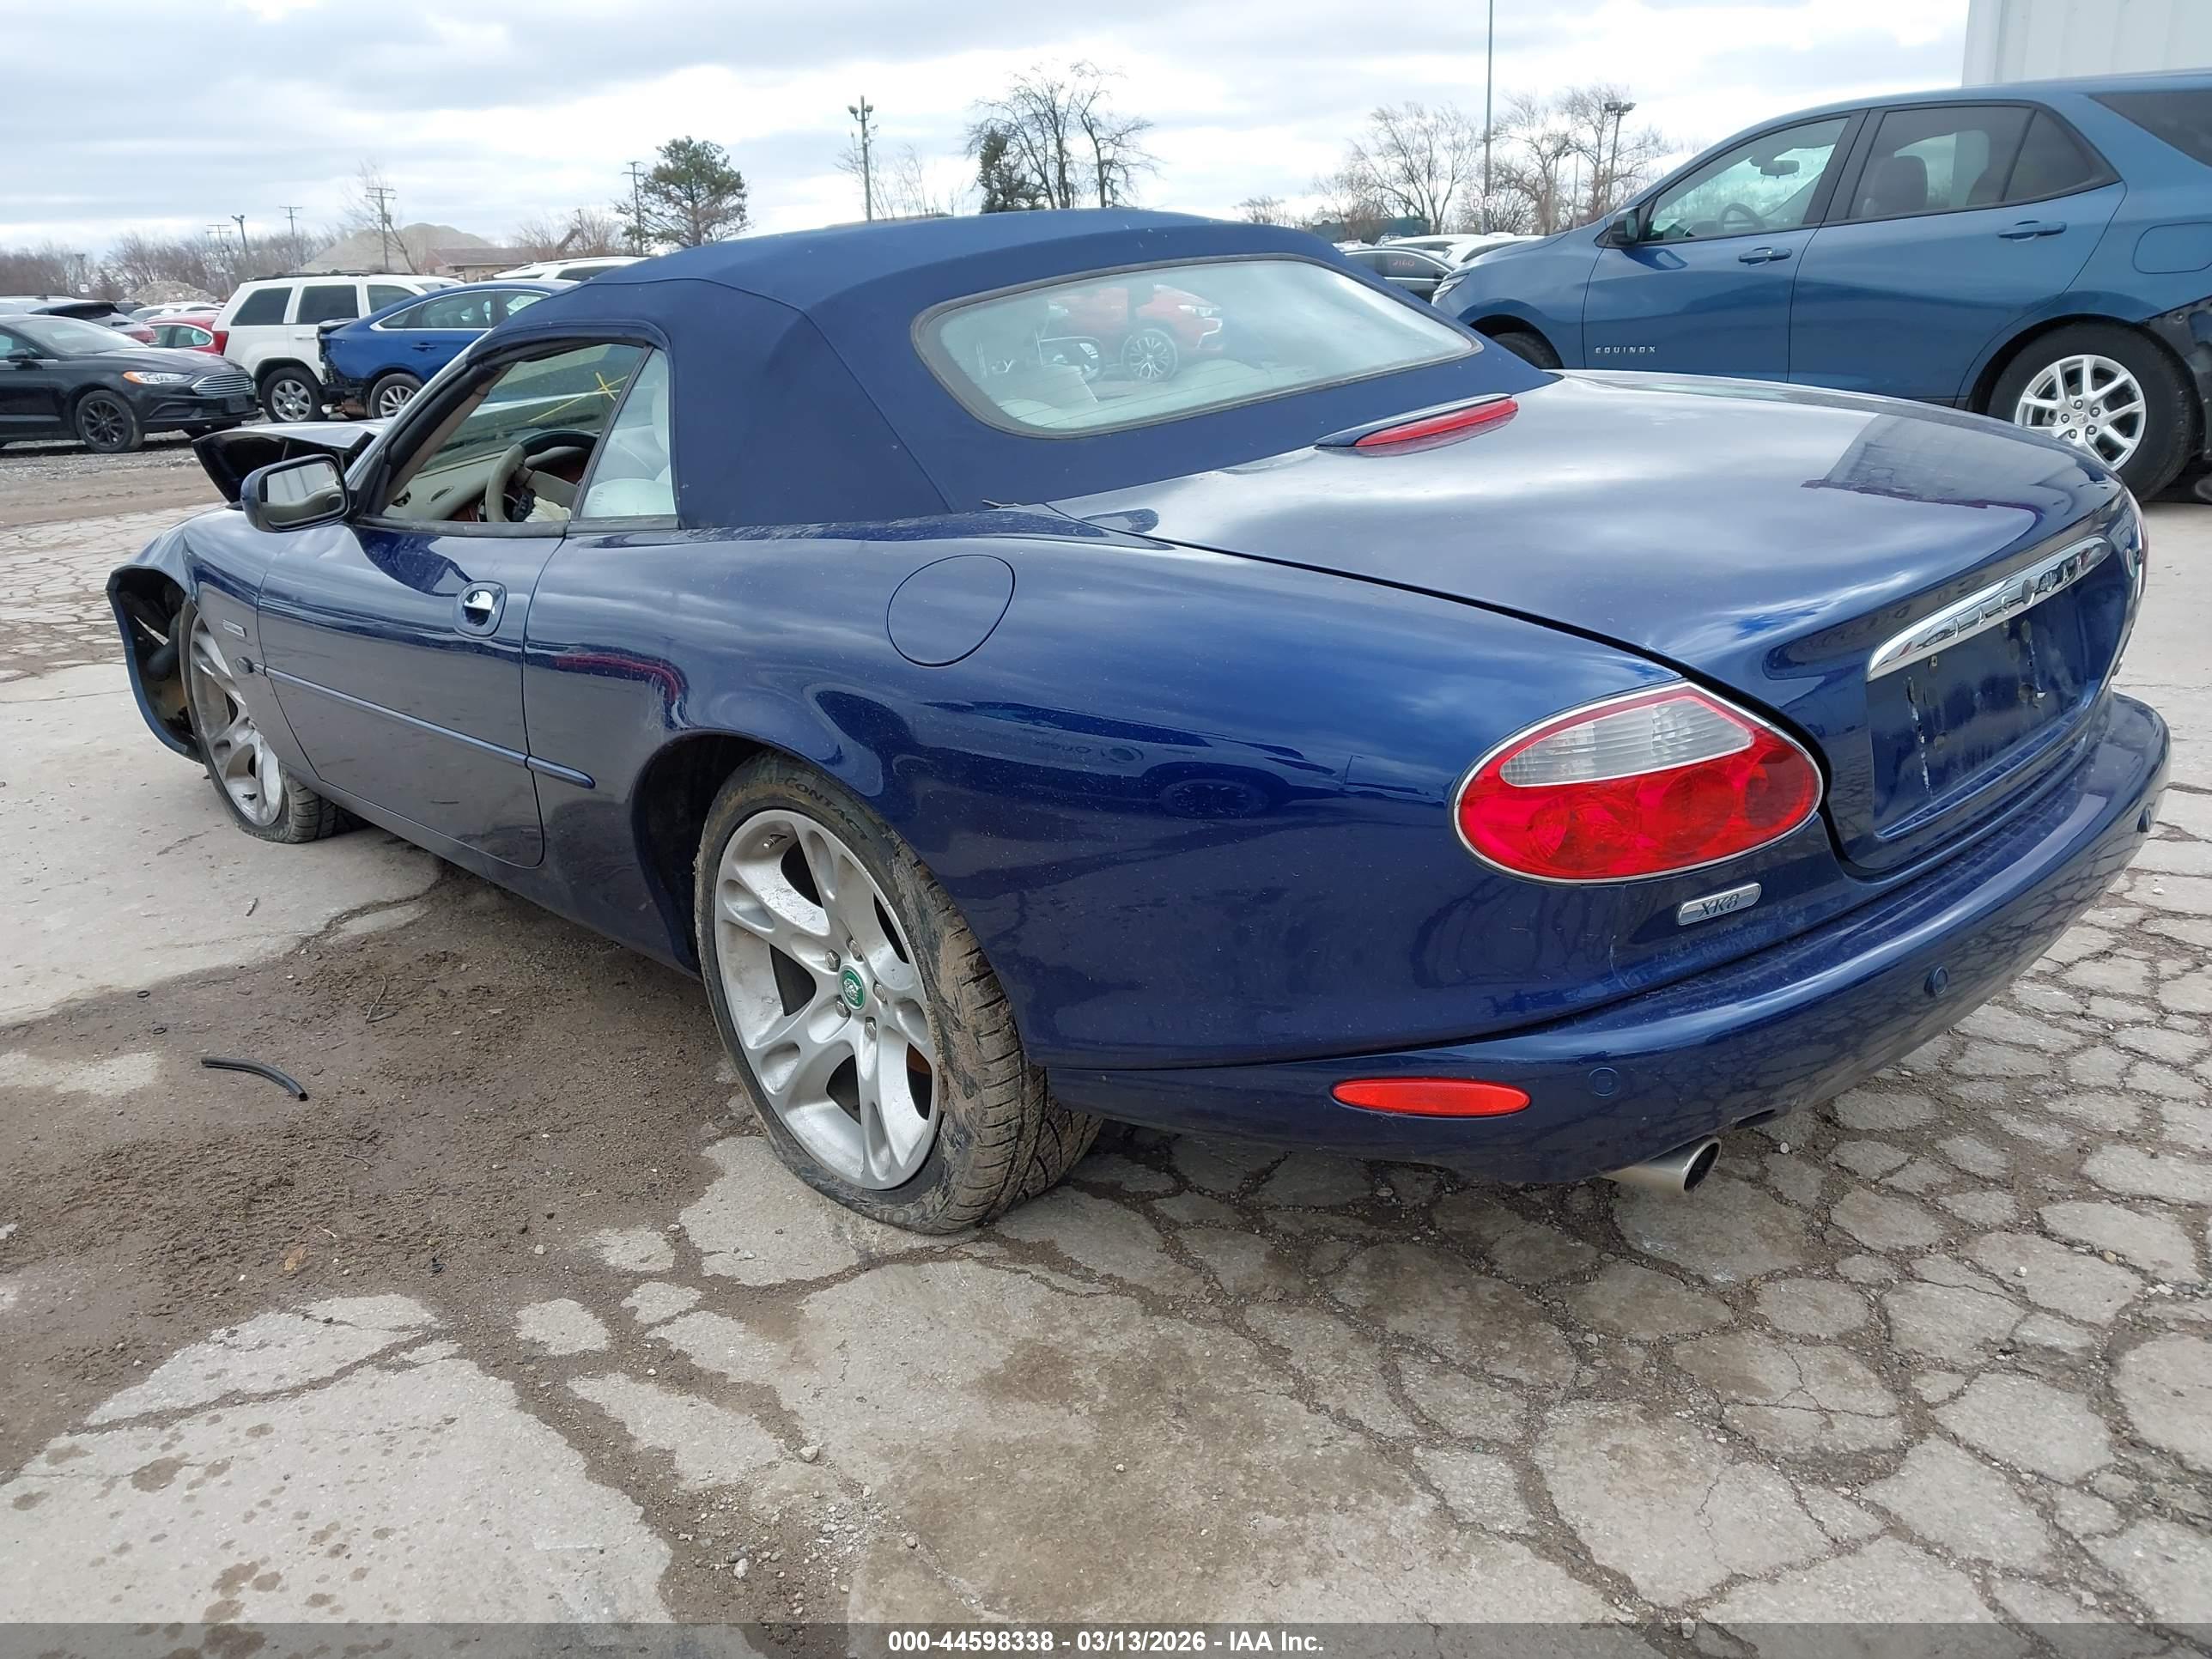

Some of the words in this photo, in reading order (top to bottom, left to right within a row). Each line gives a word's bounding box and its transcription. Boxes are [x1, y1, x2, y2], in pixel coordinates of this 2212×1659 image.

[1473, 198, 1480, 208] D
[1486, 198, 1493, 207] C
[1595, 346, 1656, 355] EQUINOX
[1954, 555, 2085, 639] JAGUAR
[1698, 893, 1740, 918] XK8
